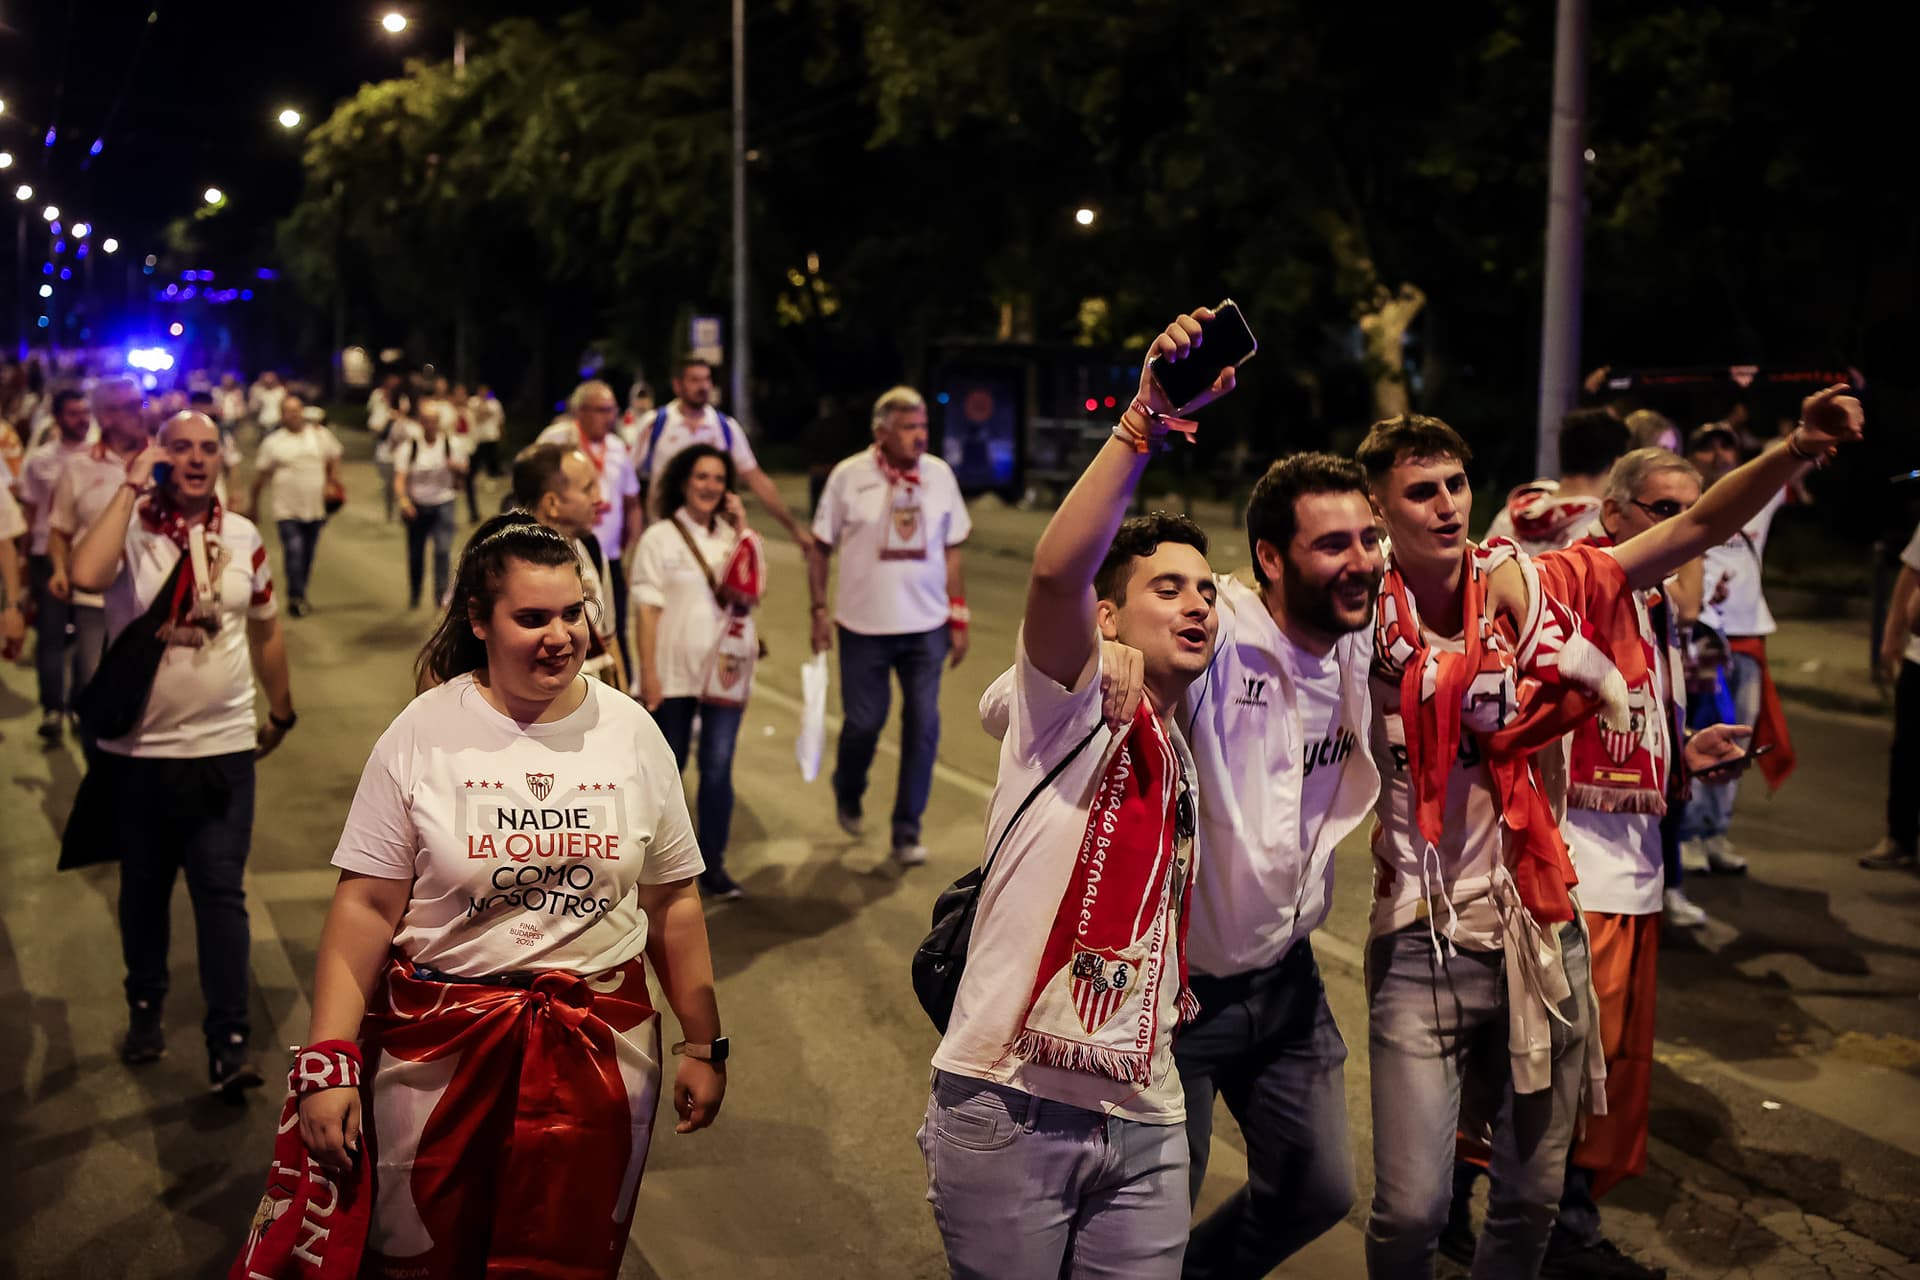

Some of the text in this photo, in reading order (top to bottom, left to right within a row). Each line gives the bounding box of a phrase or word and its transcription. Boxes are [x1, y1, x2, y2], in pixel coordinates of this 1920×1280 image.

[497, 807, 591, 830] NADIE
[467, 832, 620, 863] LA QUIERE
[491, 864, 594, 891] COMO
[1077, 836, 1112, 936] Bernabeu
[466, 887, 610, 919] NOSOTROS
[510, 927, 545, 940] BUDAPEST
[519, 922, 538, 932] FINAL
[515, 937, 535, 947] 2023
[1135, 1013, 1151, 1050] Club
